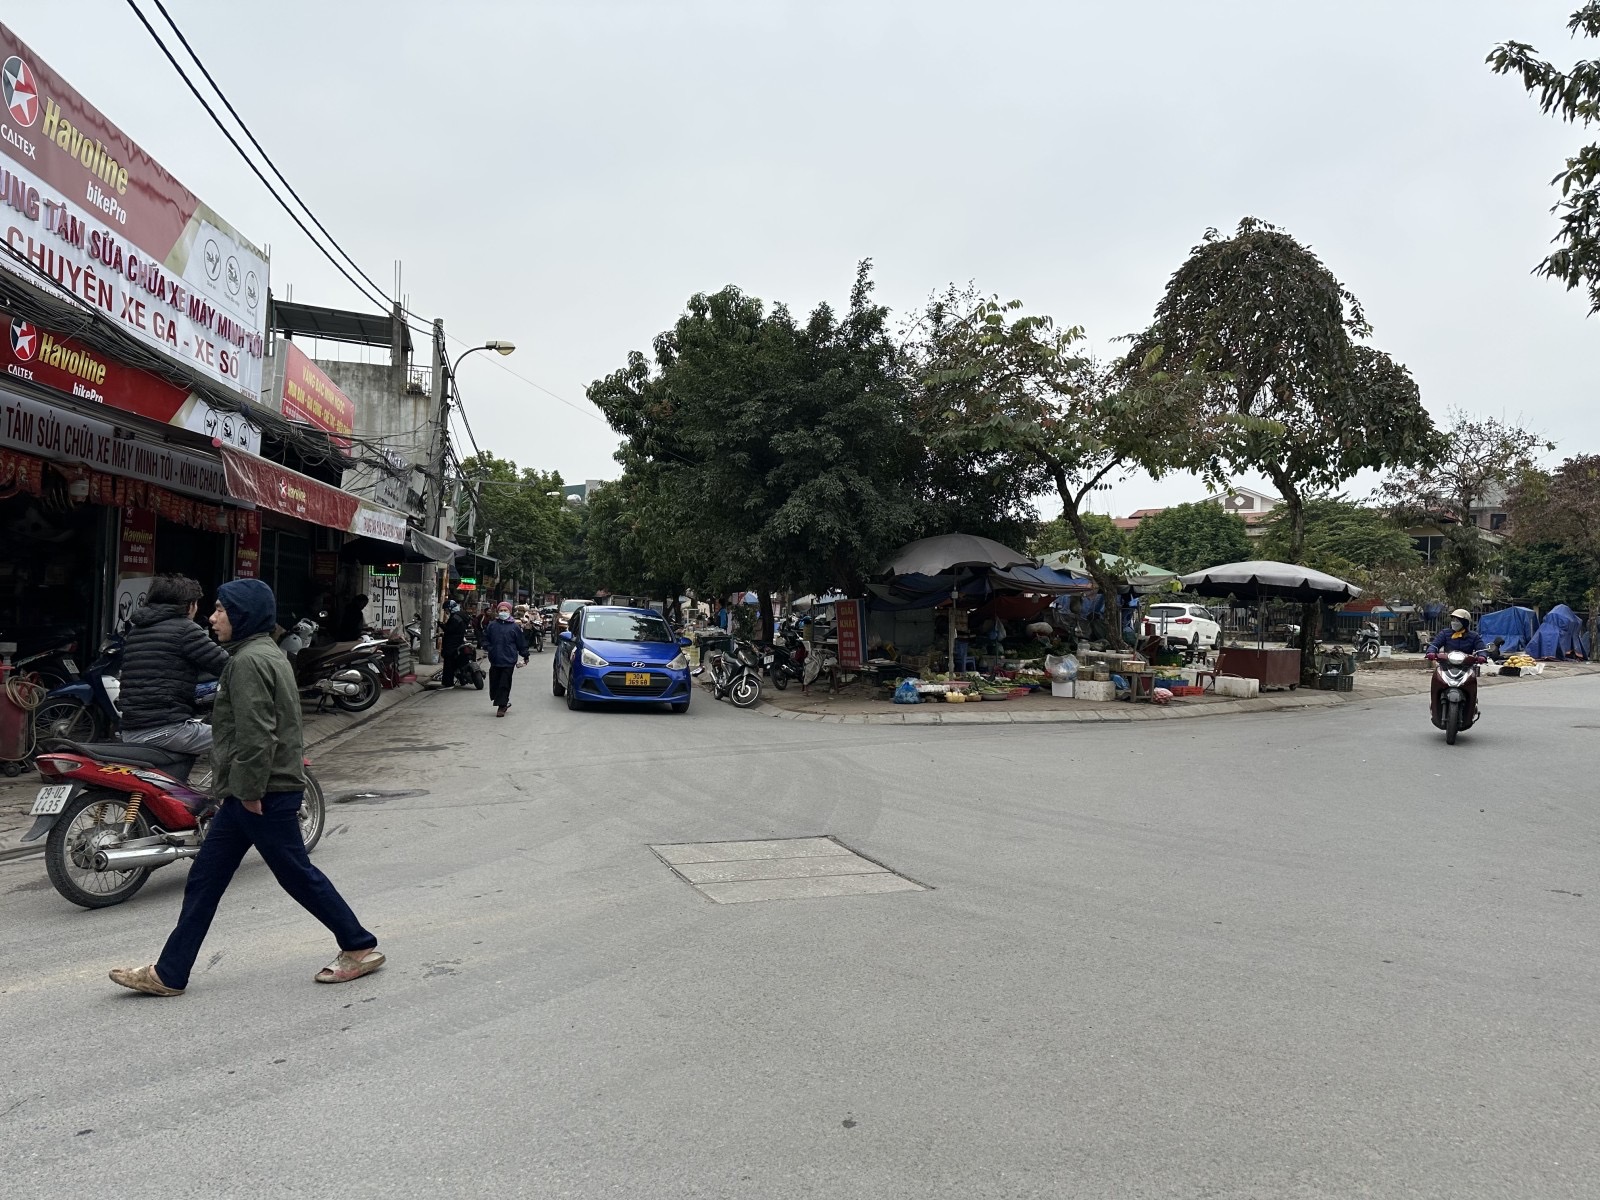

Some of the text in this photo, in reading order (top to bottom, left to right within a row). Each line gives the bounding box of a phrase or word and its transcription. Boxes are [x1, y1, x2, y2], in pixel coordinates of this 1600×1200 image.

[1, 123, 36, 160] CALTEX
[42, 96, 129, 196] Havoline
[86, 181, 126, 224] bikePro
[42, 197, 85, 249] TÂM
[88, 231, 123, 274] SỬA
[126, 254, 166, 301] CHỮA
[169, 281, 186, 313] XE
[186, 296, 216, 329] MÁY
[216, 312, 245, 348] MINH
[7, 226, 113, 312] CHUYÊN
[121, 291, 146, 330] XE
[153, 312, 178, 347] GA
[195, 334, 215, 367] XE
[219, 350, 239, 379] SỐ
[8, 363, 34, 380] CALTEX
[39, 332, 106, 385] Havoline
[73, 382, 103, 403] bikePro
[7, 402, 34, 444] TÂM
[37, 410, 60, 451] SỬA
[64, 424, 93, 460] CHỮA
[96, 435, 110, 464] XE
[135, 447, 158, 477] MINH
[160, 451, 173, 481] TỚI
[180, 457, 198, 489] KÍNH
[200, 465, 219, 494] CHÀO
[385, 605, 396, 616] TẠO
[35, 800, 59, 812] 4435
